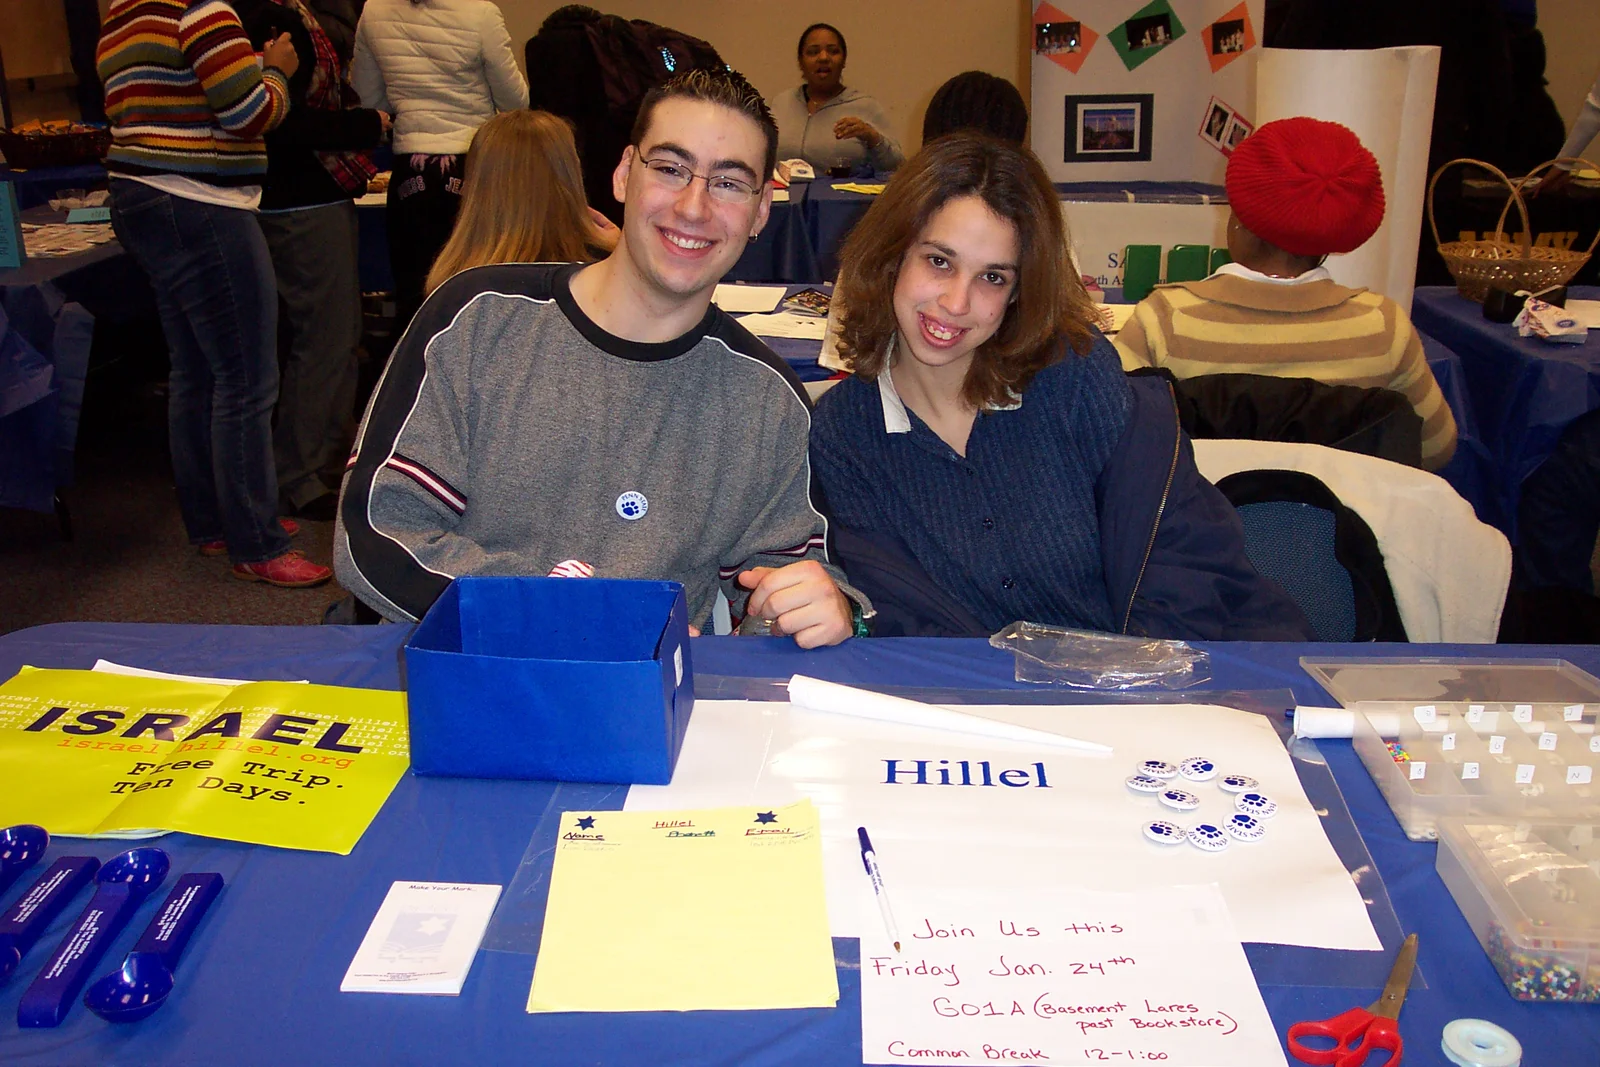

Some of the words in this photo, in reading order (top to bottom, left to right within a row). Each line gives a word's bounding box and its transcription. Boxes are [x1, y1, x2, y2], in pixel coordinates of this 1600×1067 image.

[23, 706, 365, 754] ISRAEL
[57, 736, 355, 770] israel.hillel.org
[126, 757, 214, 777] Free
[243, 761, 345, 791] Trip.
[879, 759, 1054, 788] Hillel
[110, 776, 173, 795] Ten
[197, 776, 307, 805] Days.
[562, 831, 604, 841] Name
[912, 919, 976, 939] Join
[999, 920, 1041, 938] Us
[1064, 922, 1124, 935] this
[870, 956, 961, 987] Friday
[988, 955, 1053, 977] Jan.
[1144, 999, 1200, 1014] Lares
[1075, 1018, 1114, 1036] past
[887, 1041, 970, 1059] Common
[982, 1044, 1050, 1061] Break
